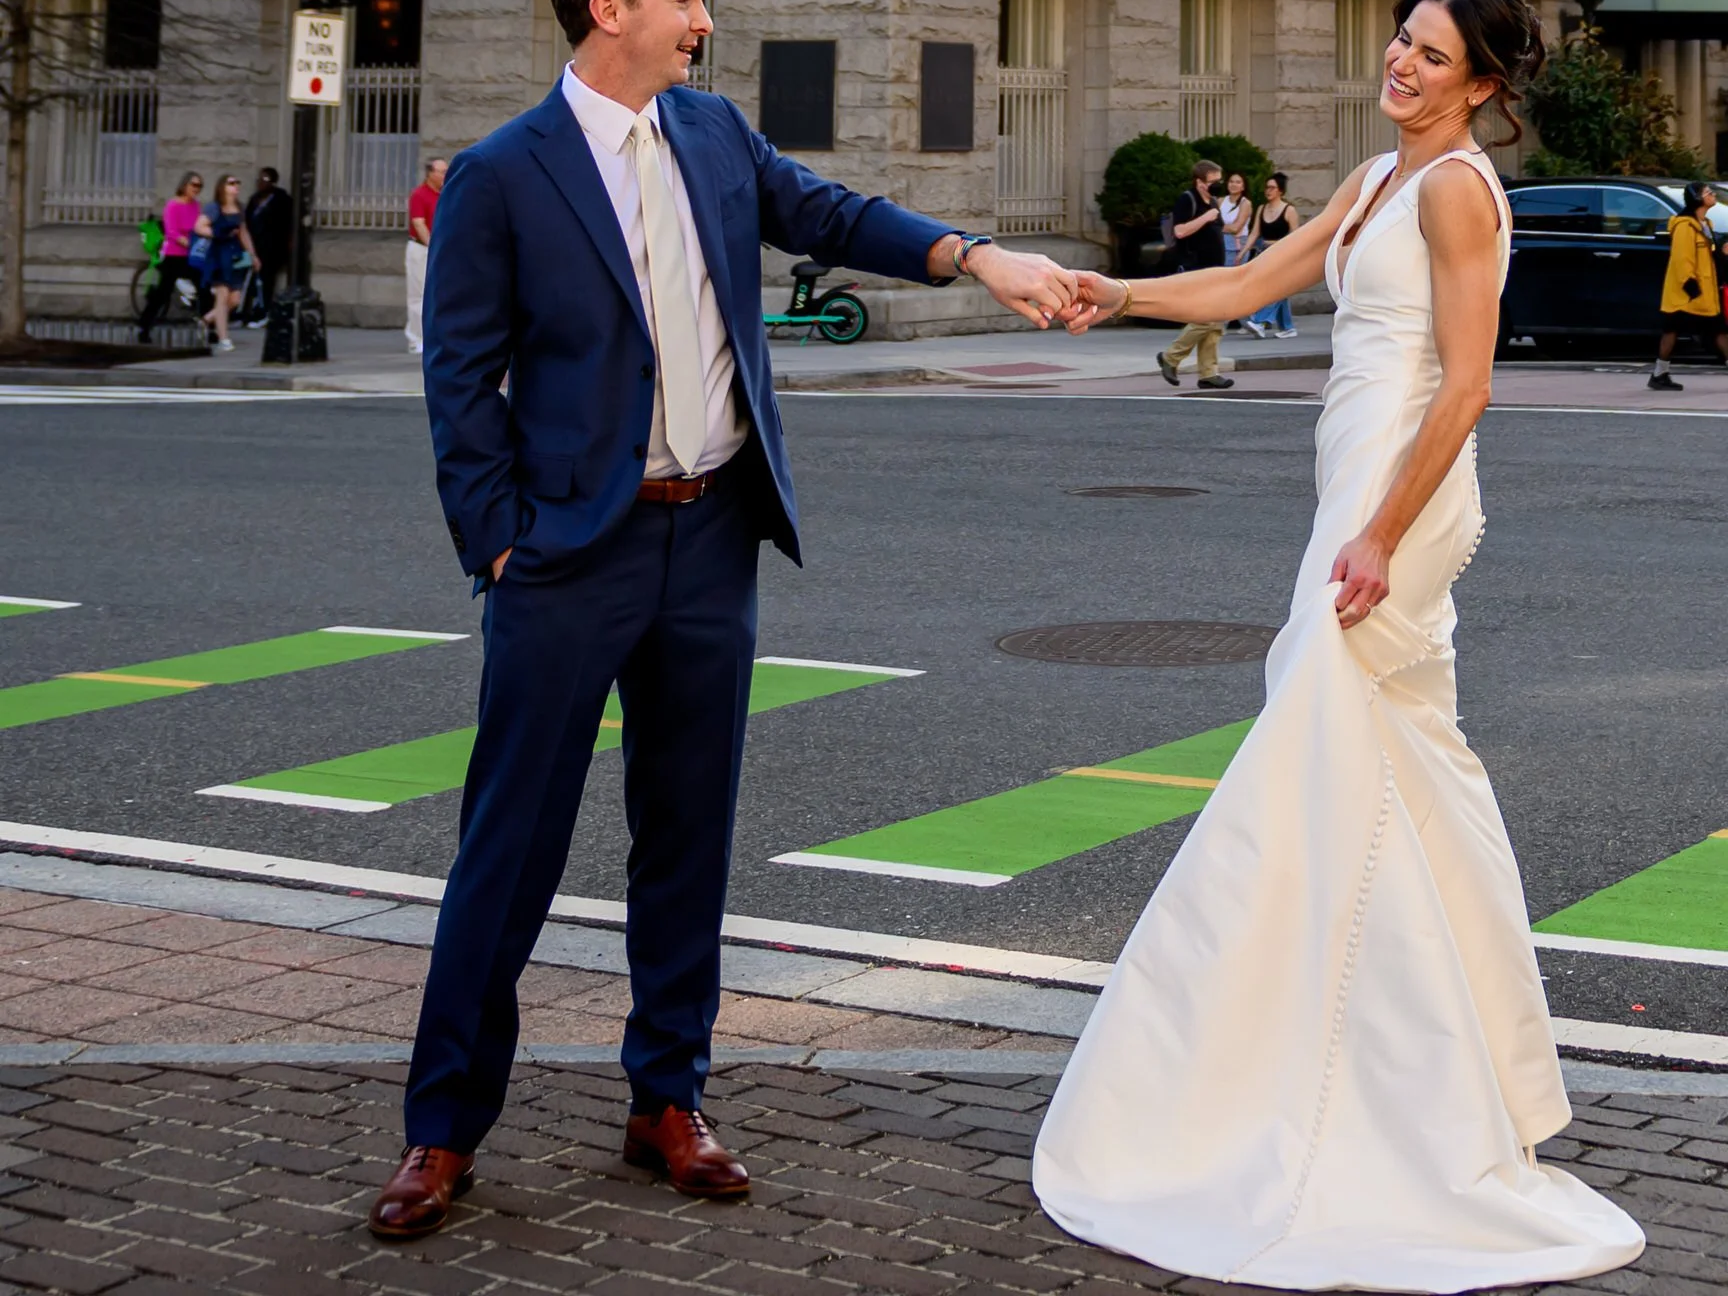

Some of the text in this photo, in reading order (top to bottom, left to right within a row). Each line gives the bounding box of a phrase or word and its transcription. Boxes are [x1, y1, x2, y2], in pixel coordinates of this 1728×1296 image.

[309, 22, 331, 39] NO
[305, 41, 334, 57] TURN
[297, 58, 337, 75] ON RED
